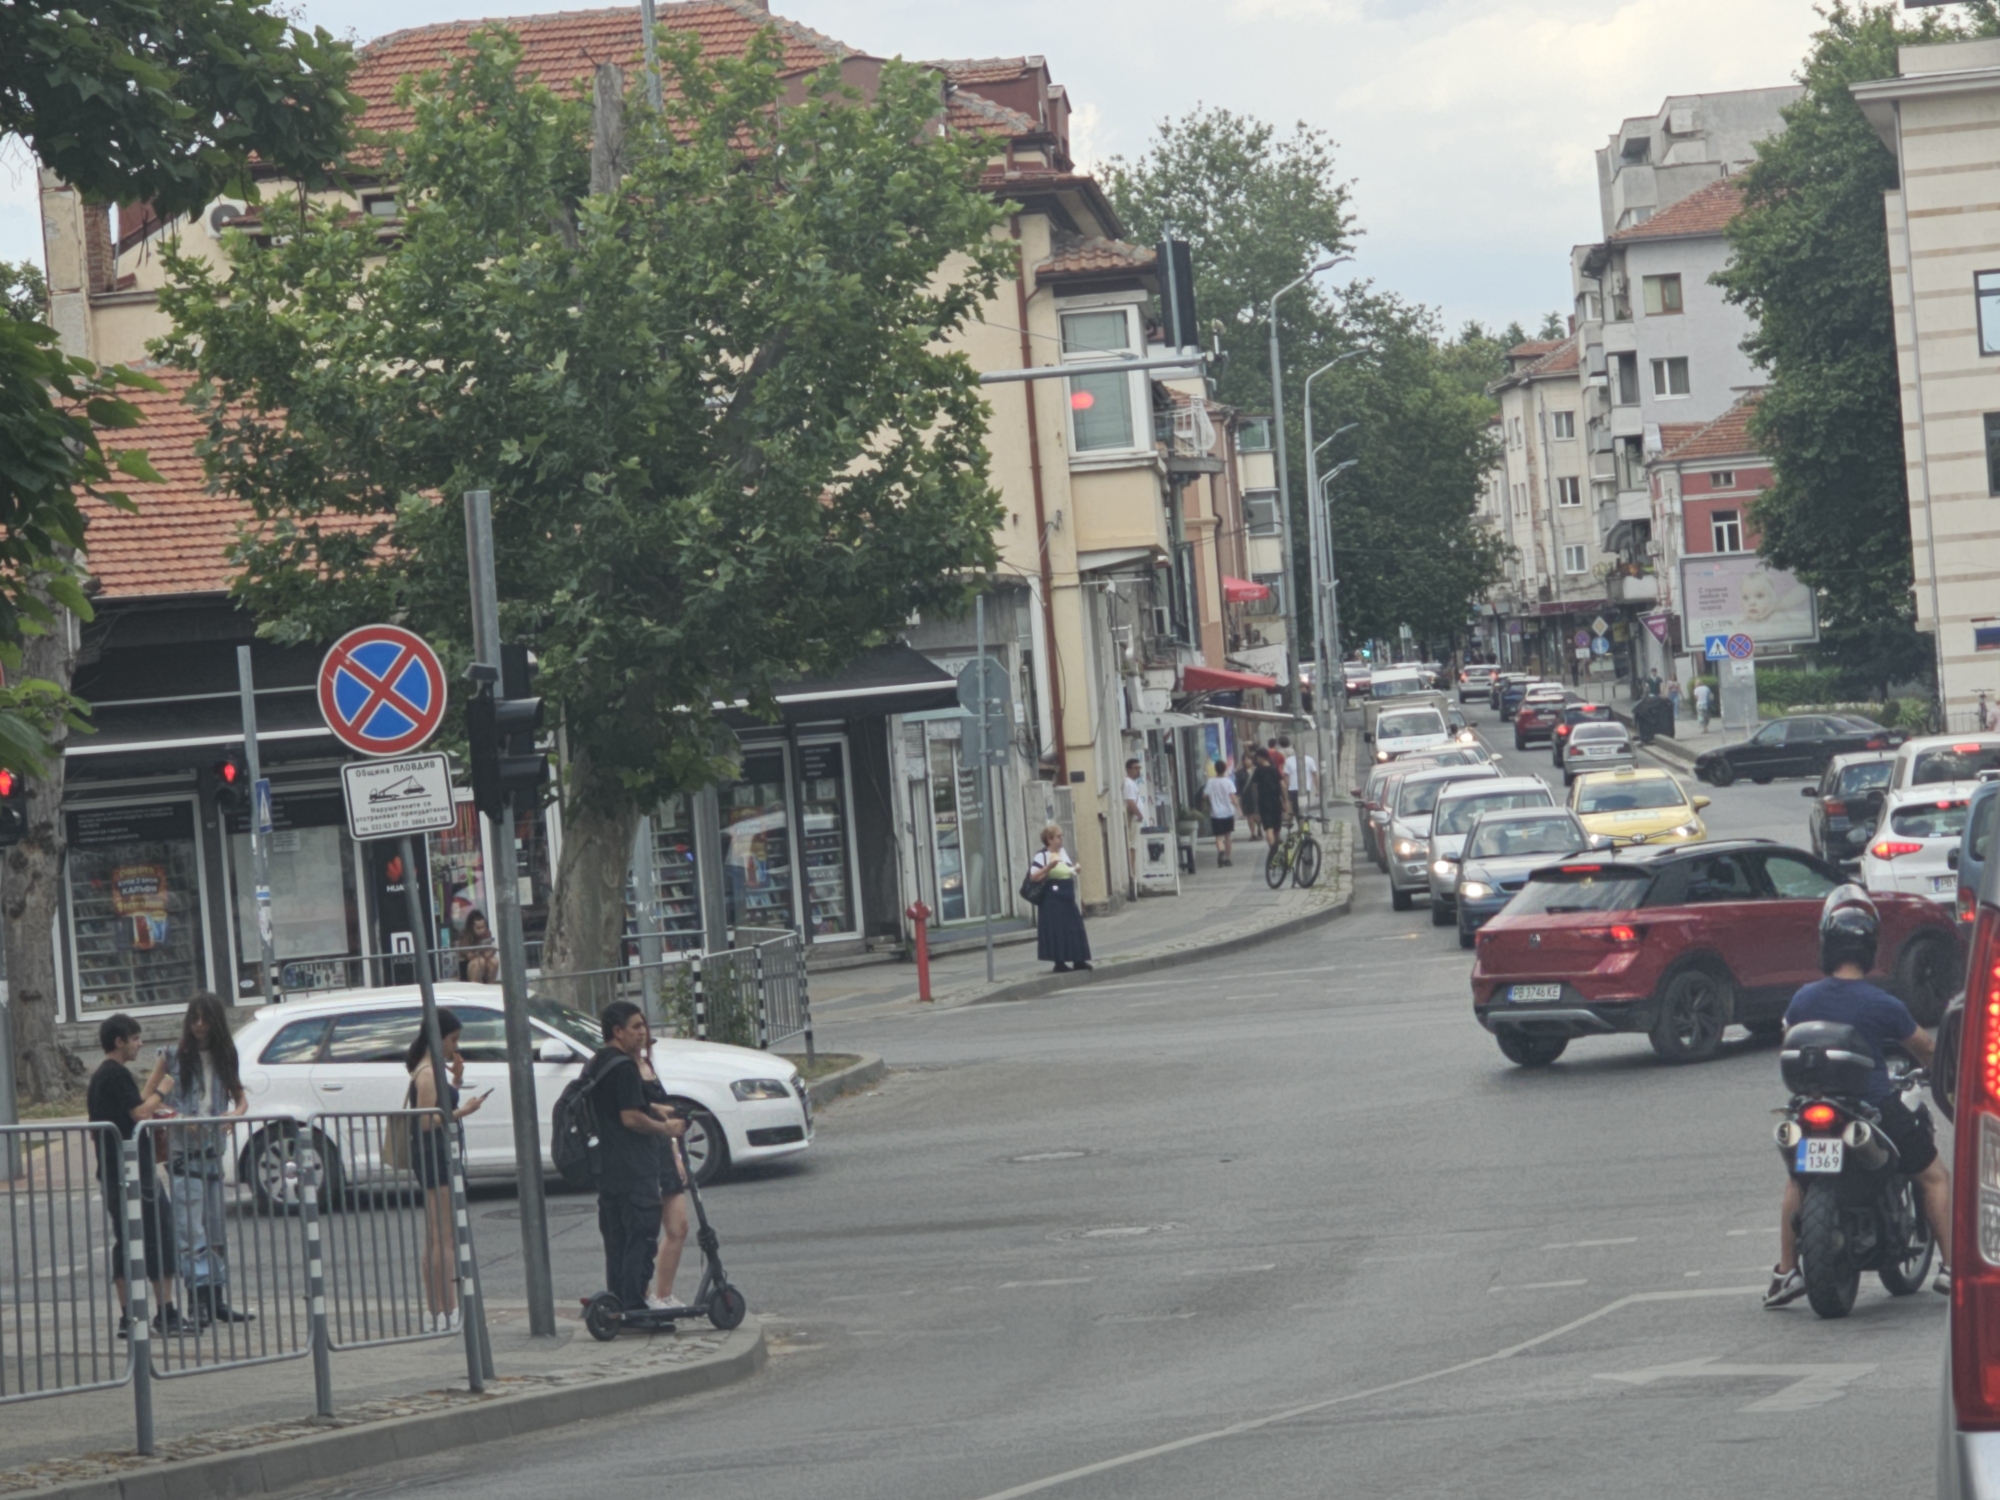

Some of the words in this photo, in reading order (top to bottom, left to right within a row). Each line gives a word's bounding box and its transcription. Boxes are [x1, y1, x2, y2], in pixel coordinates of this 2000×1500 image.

[355, 767, 390, 778] Община
[393, 760, 436, 774] ПЛОВДИВ
[371, 802, 420, 813] Нарушителите
[355, 812, 398, 823] отстраняват
[400, 806, 448, 817] принудително
[122, 885, 157, 895] КАЛЪФИ
[386, 883, 419, 892] HUAI
[1808, 1142, 1827, 1154] CM
[1810, 1156, 1839, 1168] 1369
